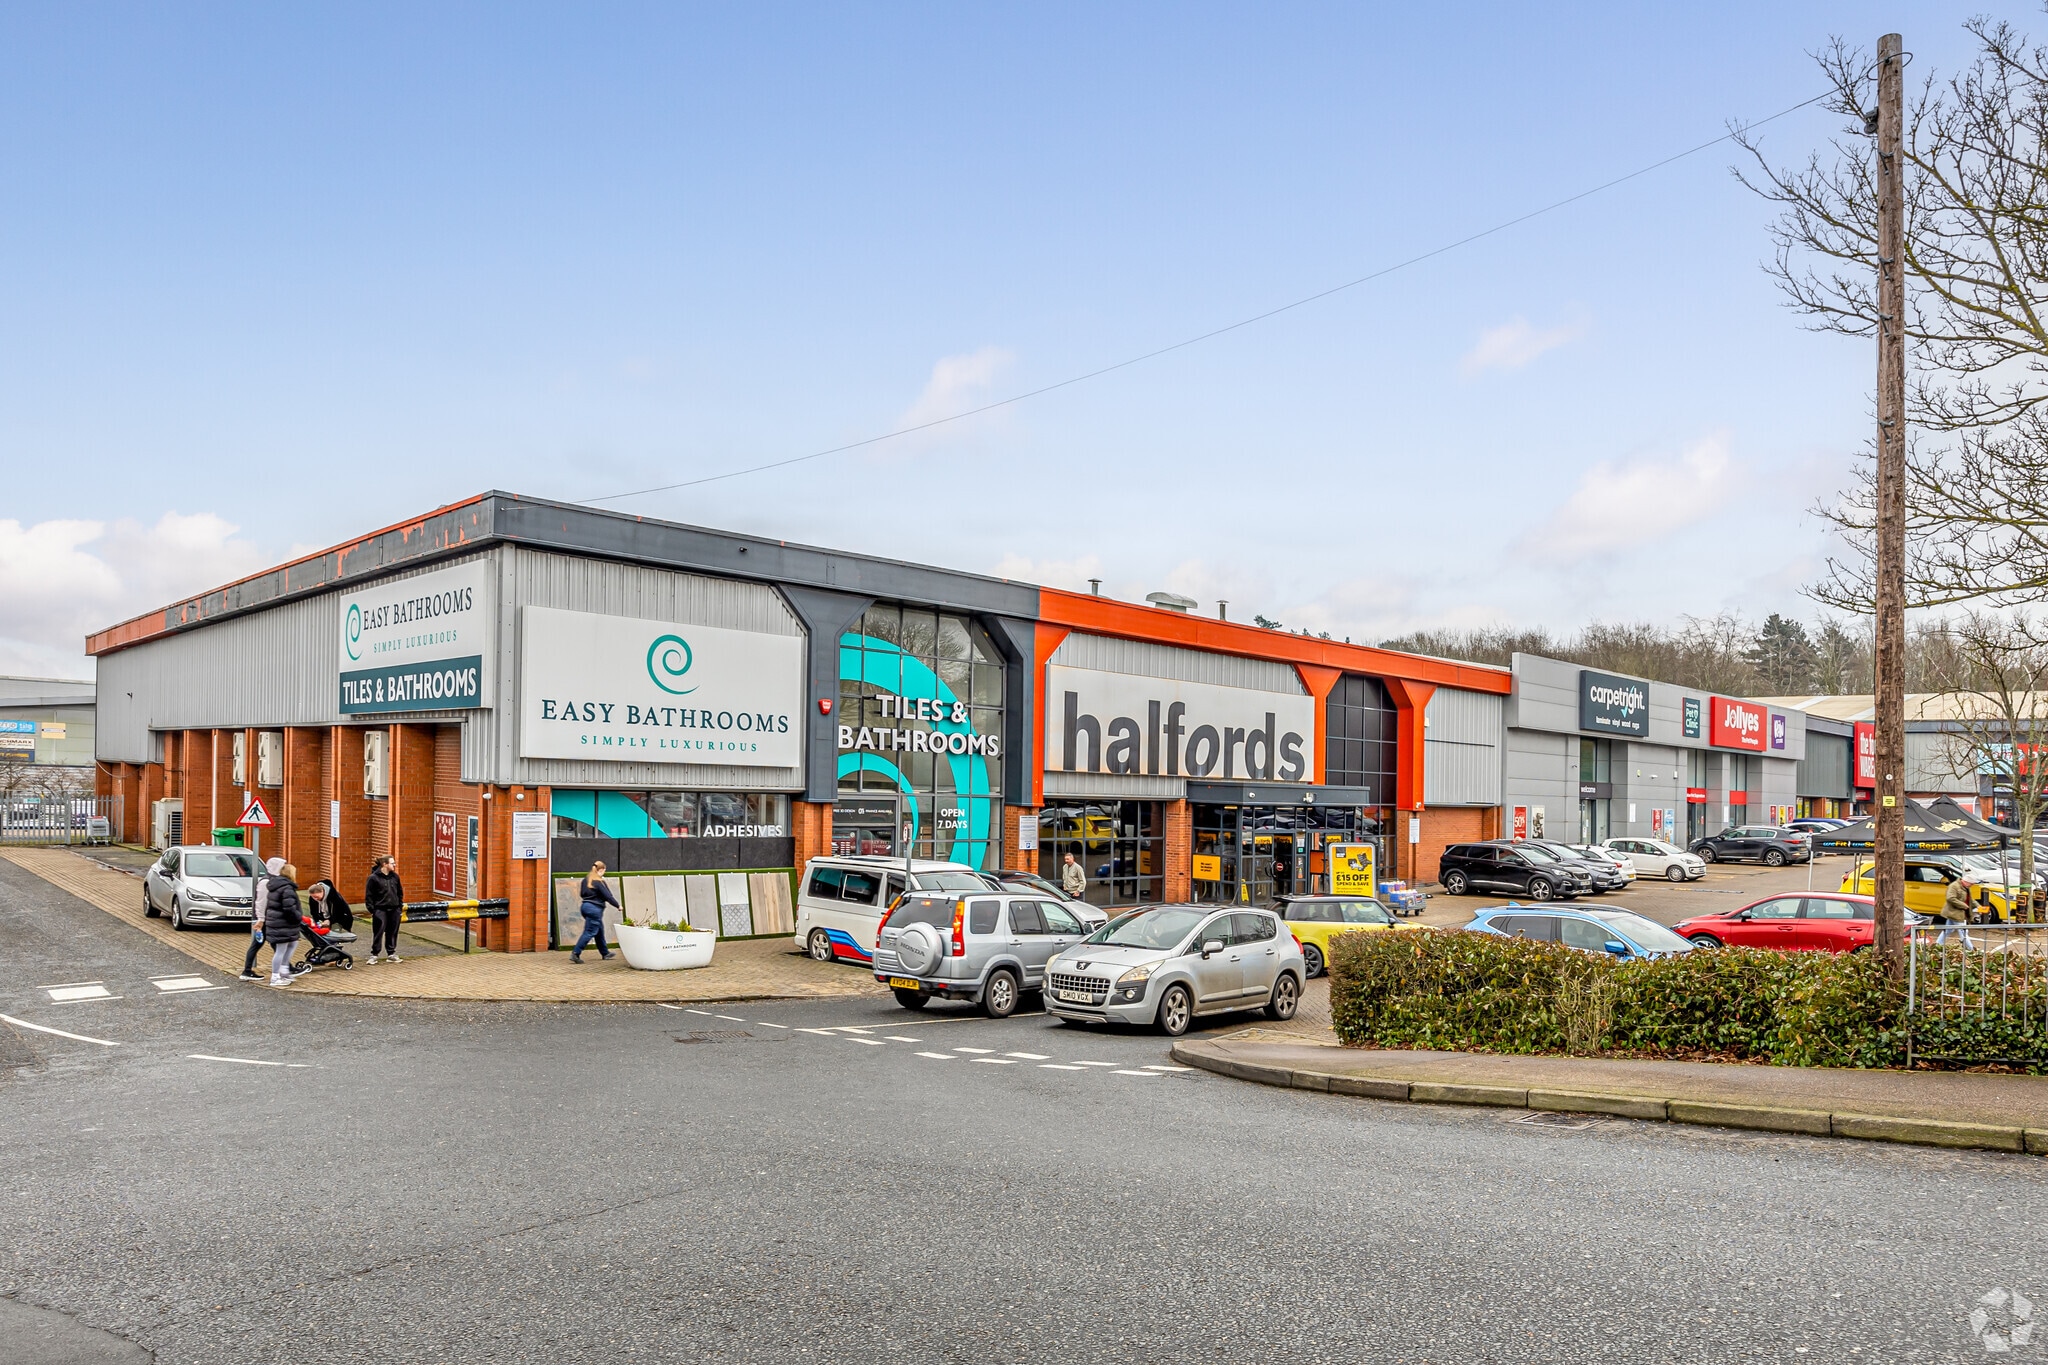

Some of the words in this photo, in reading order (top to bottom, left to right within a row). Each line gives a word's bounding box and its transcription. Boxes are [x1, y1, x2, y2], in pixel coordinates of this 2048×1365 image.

[363, 605, 390, 631] EASY
[393, 587, 473, 625] BATHROOMS
[373, 639, 402, 654] SIMPLY
[405, 629, 458, 649] LUXURIOUS
[343, 678, 373, 705] TILES
[375, 678, 385, 703] &
[387, 667, 477, 702] BATHROOMS
[541, 699, 615, 724] EASY
[626, 704, 790, 734] BATHROOMS
[876, 694, 944, 722] TILES
[951, 701, 968, 724] &
[1724, 704, 1759, 736] Jollyes
[580, 734, 649, 748] SIMPLY
[659, 738, 758, 752] LUXURIOUS
[838, 725, 999, 757] BATHROOMS
[1063, 690, 1306, 782] halfords
[940, 808, 965, 817] OPEN
[703, 824, 783, 838] ADHESIVES
[938, 820, 944, 829] 7
[945, 820, 968, 829] DAYS
[436, 846, 453, 860] SALE
[1336, 874, 1351, 882] £15
[1352, 874, 1370, 882] OFF
[900, 941, 926, 957] HONDA
[1076, 992, 1089, 1001] VGX
